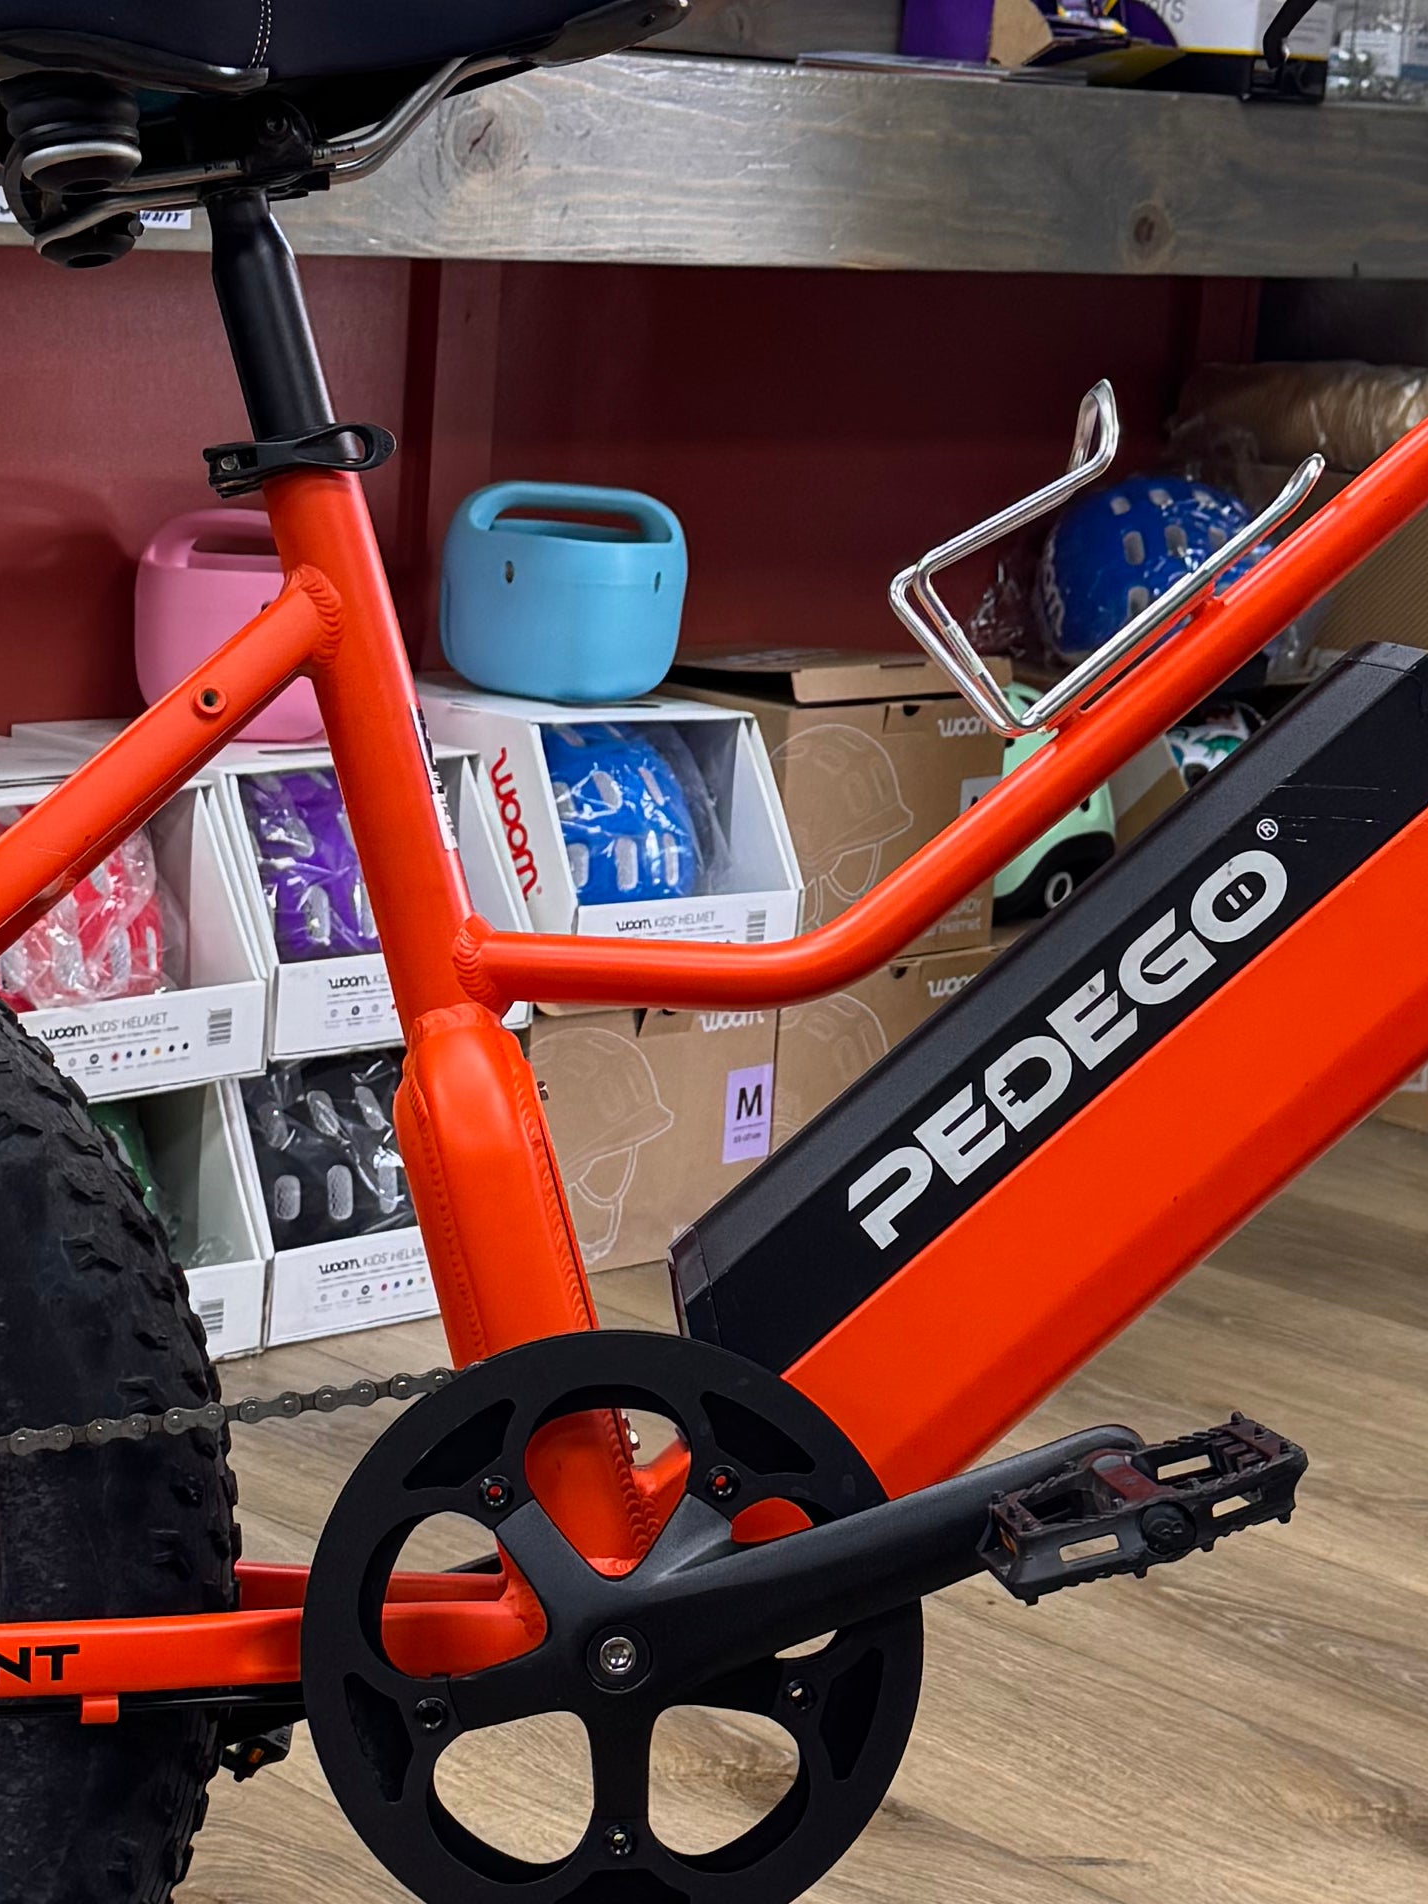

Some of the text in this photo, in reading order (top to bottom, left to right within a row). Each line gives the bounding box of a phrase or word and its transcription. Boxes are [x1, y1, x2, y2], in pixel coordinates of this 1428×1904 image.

[490, 746, 541, 902] woom
[615, 917, 653, 932] woom
[676, 910, 716, 928] HELMET
[327, 974, 372, 990] woom
[40, 1024, 89, 1042] woom
[121, 1011, 169, 1030] HELMET
[845, 846, 1290, 1252] PEDEGO
[735, 1083, 763, 1120] M
[318, 1260, 362, 1276] woom
